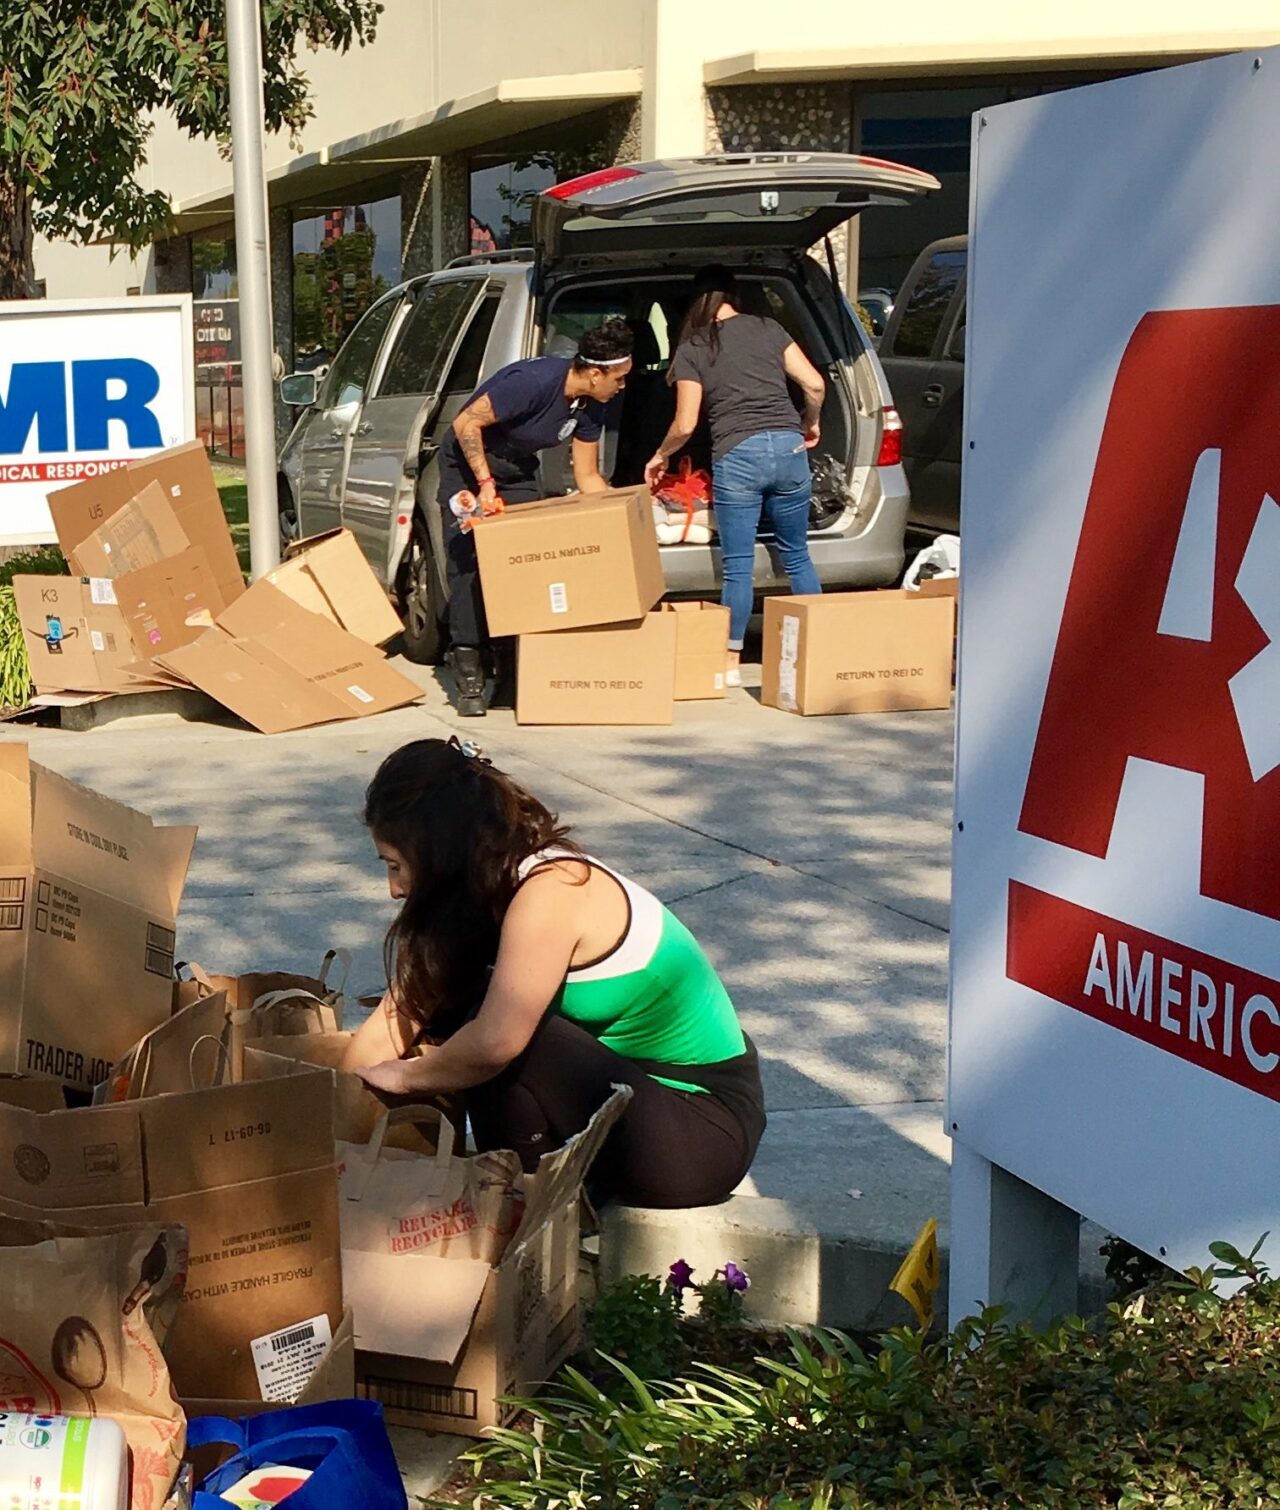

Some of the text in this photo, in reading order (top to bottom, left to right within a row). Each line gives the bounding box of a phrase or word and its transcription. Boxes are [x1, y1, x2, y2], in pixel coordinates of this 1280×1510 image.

[88, 504, 104, 519] U5
[509, 545, 600, 565] RETURN TO REI DC
[41, 589, 58, 603] K3
[836, 667, 924, 680] RETURN TO REI DC
[550, 680, 643, 689] RETURN TO REI DC
[1083, 932, 1280, 1073] AMERIC
[26, 1040, 84, 1082] TRADER
[272, 1266, 313, 1284] FRAGILE
[203, 1284, 229, 1298] WITH
[231, 1275, 270, 1293] HANDLE
